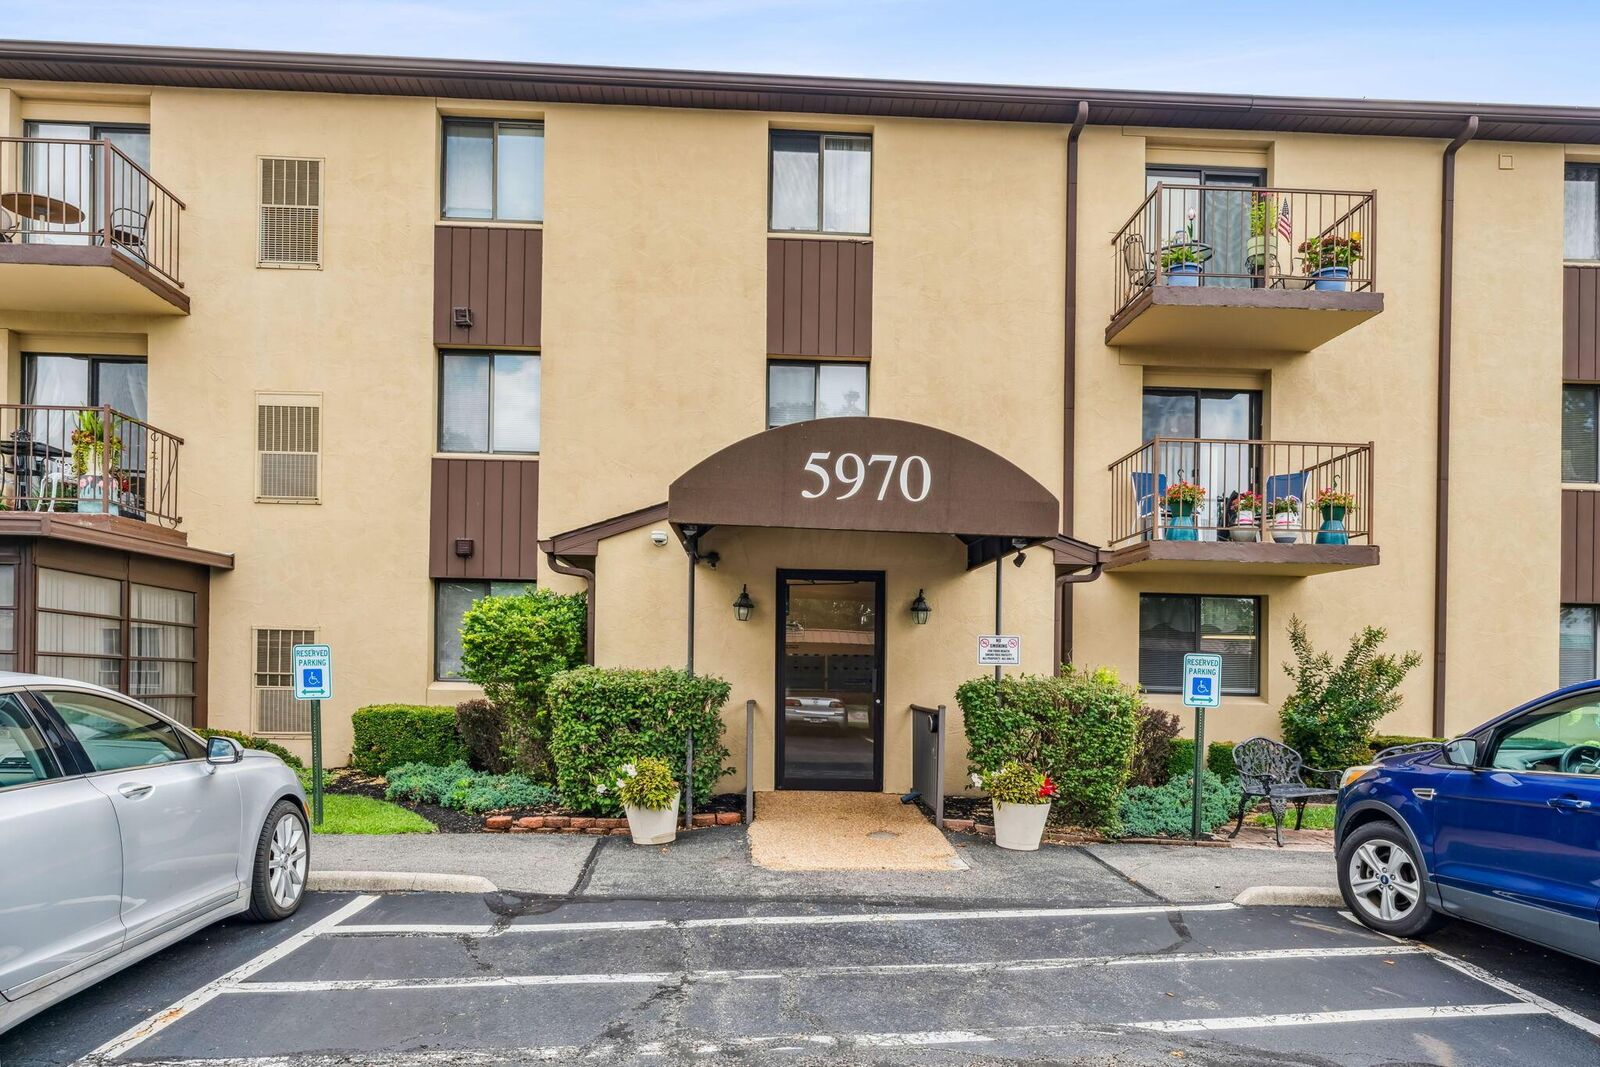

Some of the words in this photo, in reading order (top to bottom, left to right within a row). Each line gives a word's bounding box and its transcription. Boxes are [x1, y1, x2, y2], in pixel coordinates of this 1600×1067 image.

[801, 451, 931, 502] 5970
[296, 649, 328, 657] RESERVED
[298, 659, 327, 667] PARKING
[1186, 658, 1219, 667] RESERVED
[1188, 667, 1217, 676] PARKING
